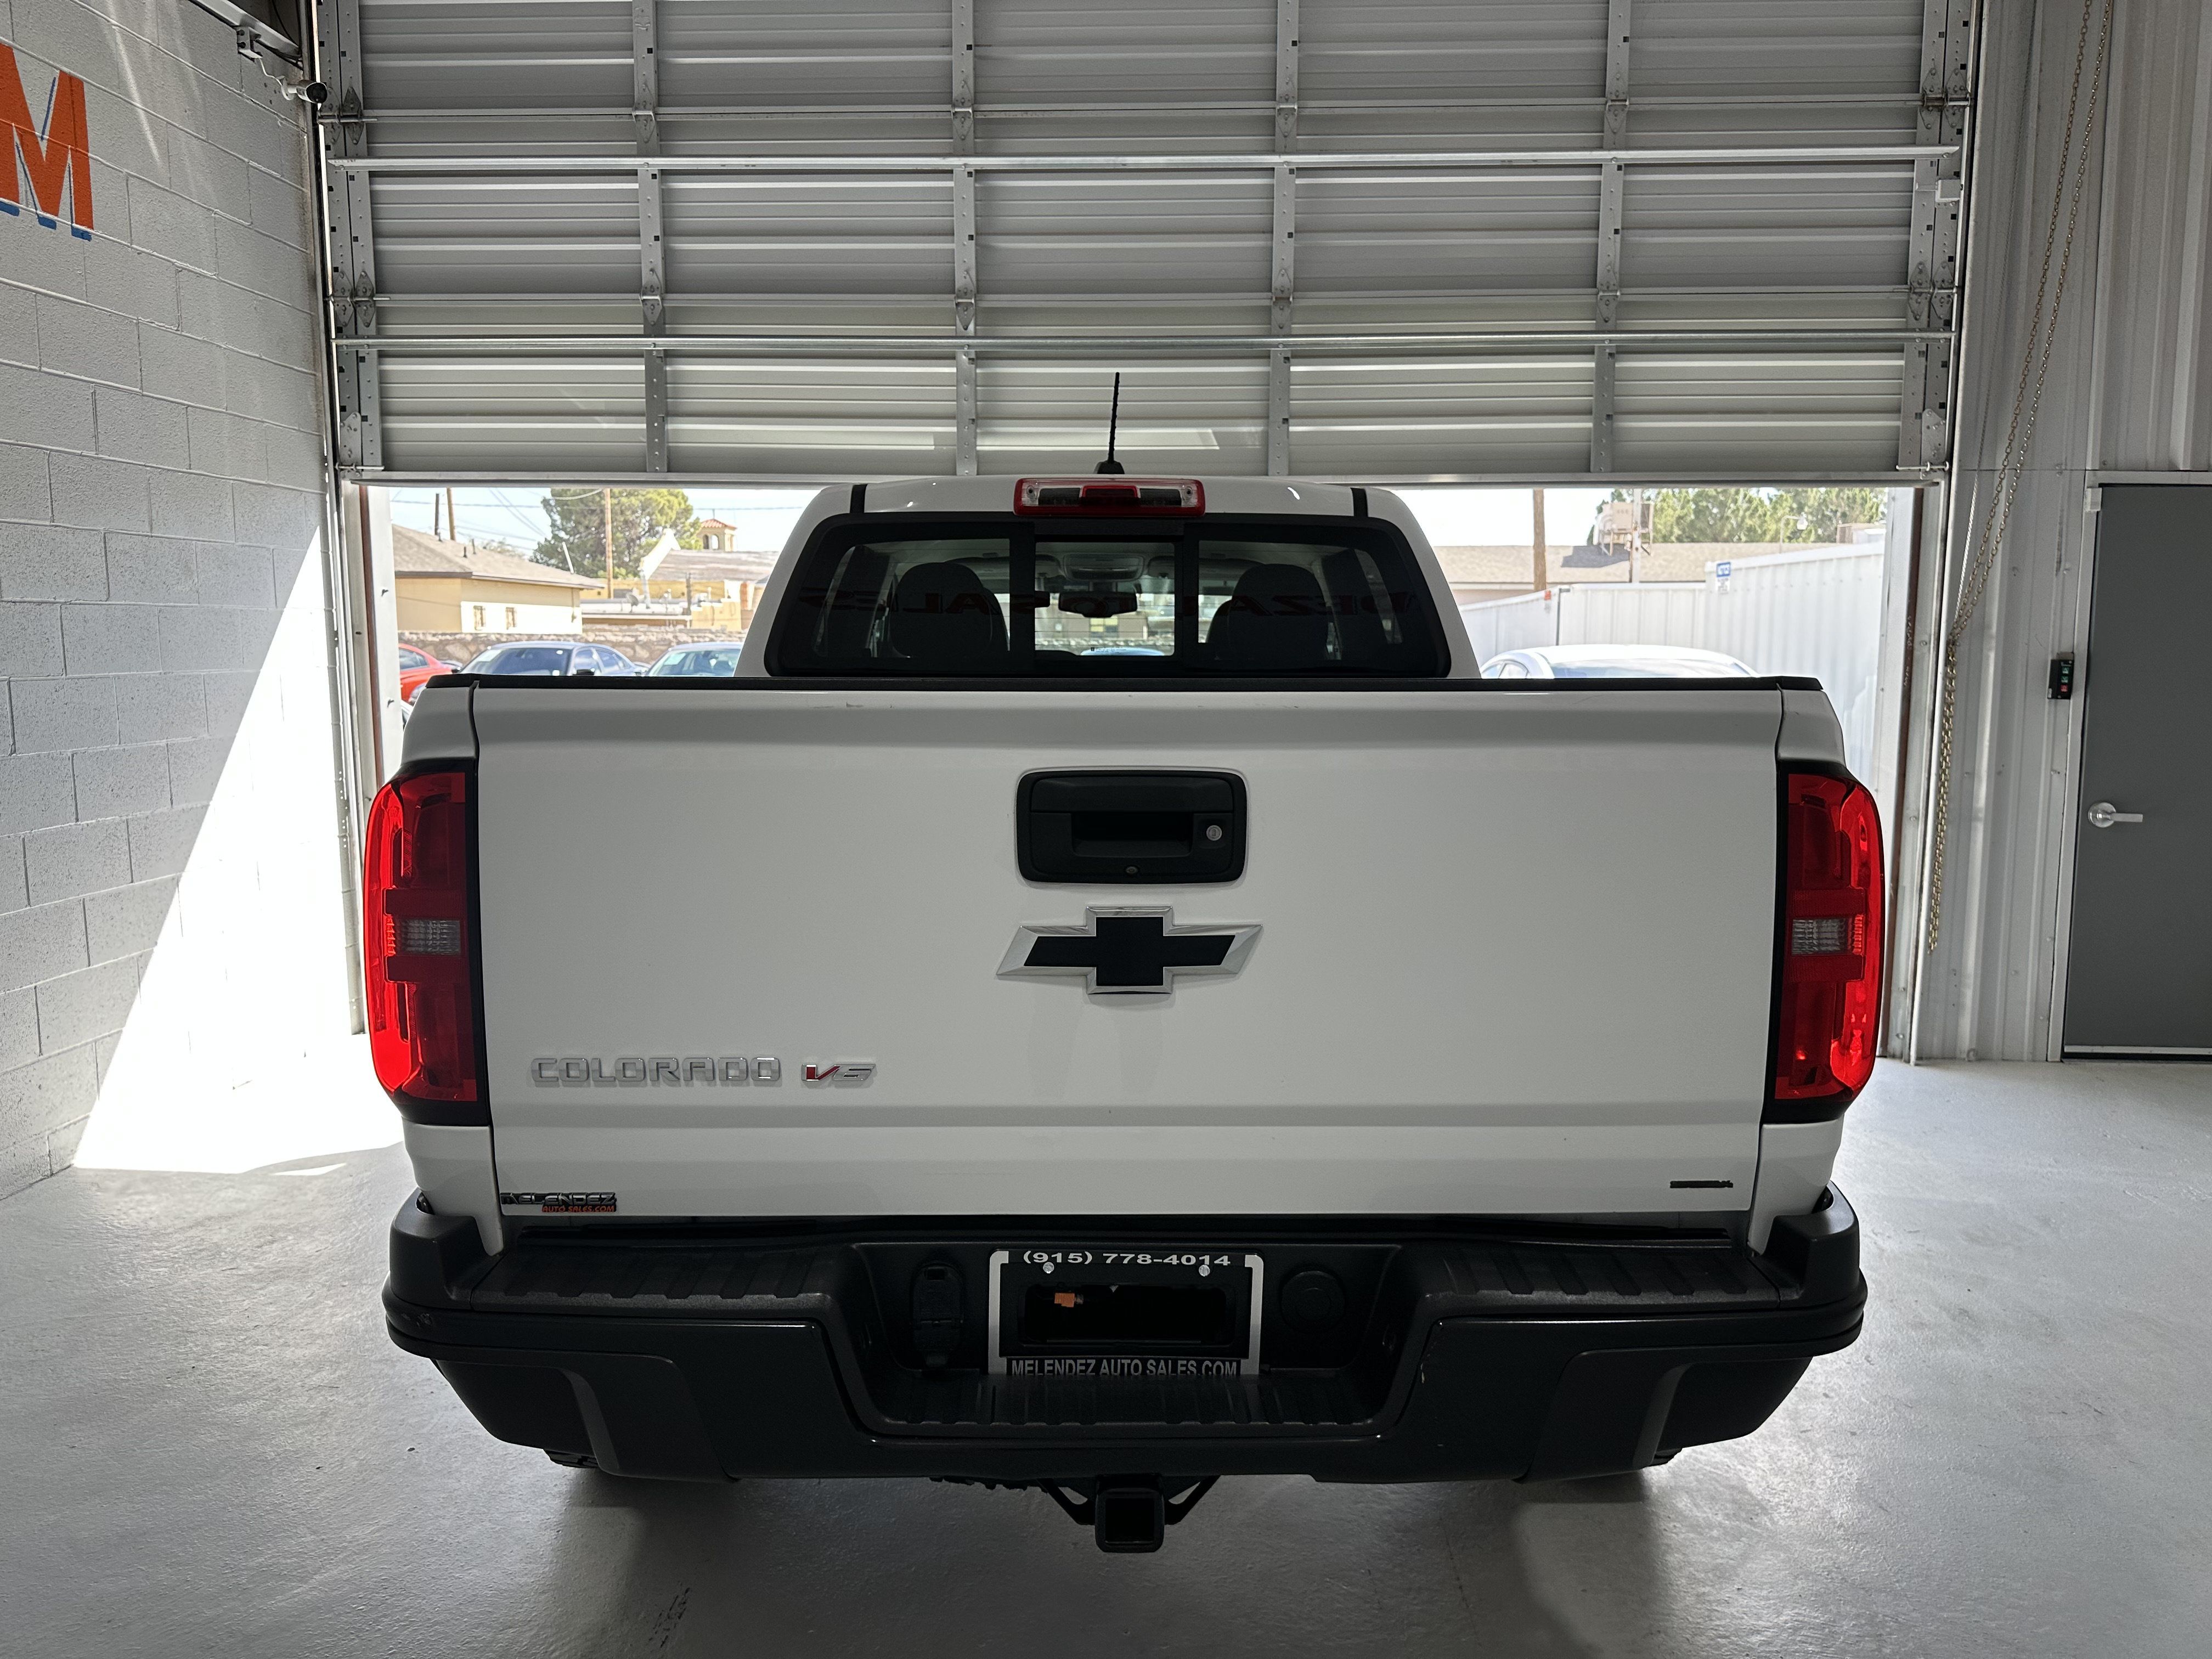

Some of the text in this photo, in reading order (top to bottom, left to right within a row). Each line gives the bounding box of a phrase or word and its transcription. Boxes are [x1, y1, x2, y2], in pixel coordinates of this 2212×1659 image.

[531, 1057, 876, 1084] COLORADO V6
[500, 1192, 616, 1206] MELENDEZ
[1023, 1250, 1231, 1266] (915) 778-4014
[1012, 1359, 1237, 1376] MELENDEZ AUTO SALES.COM
